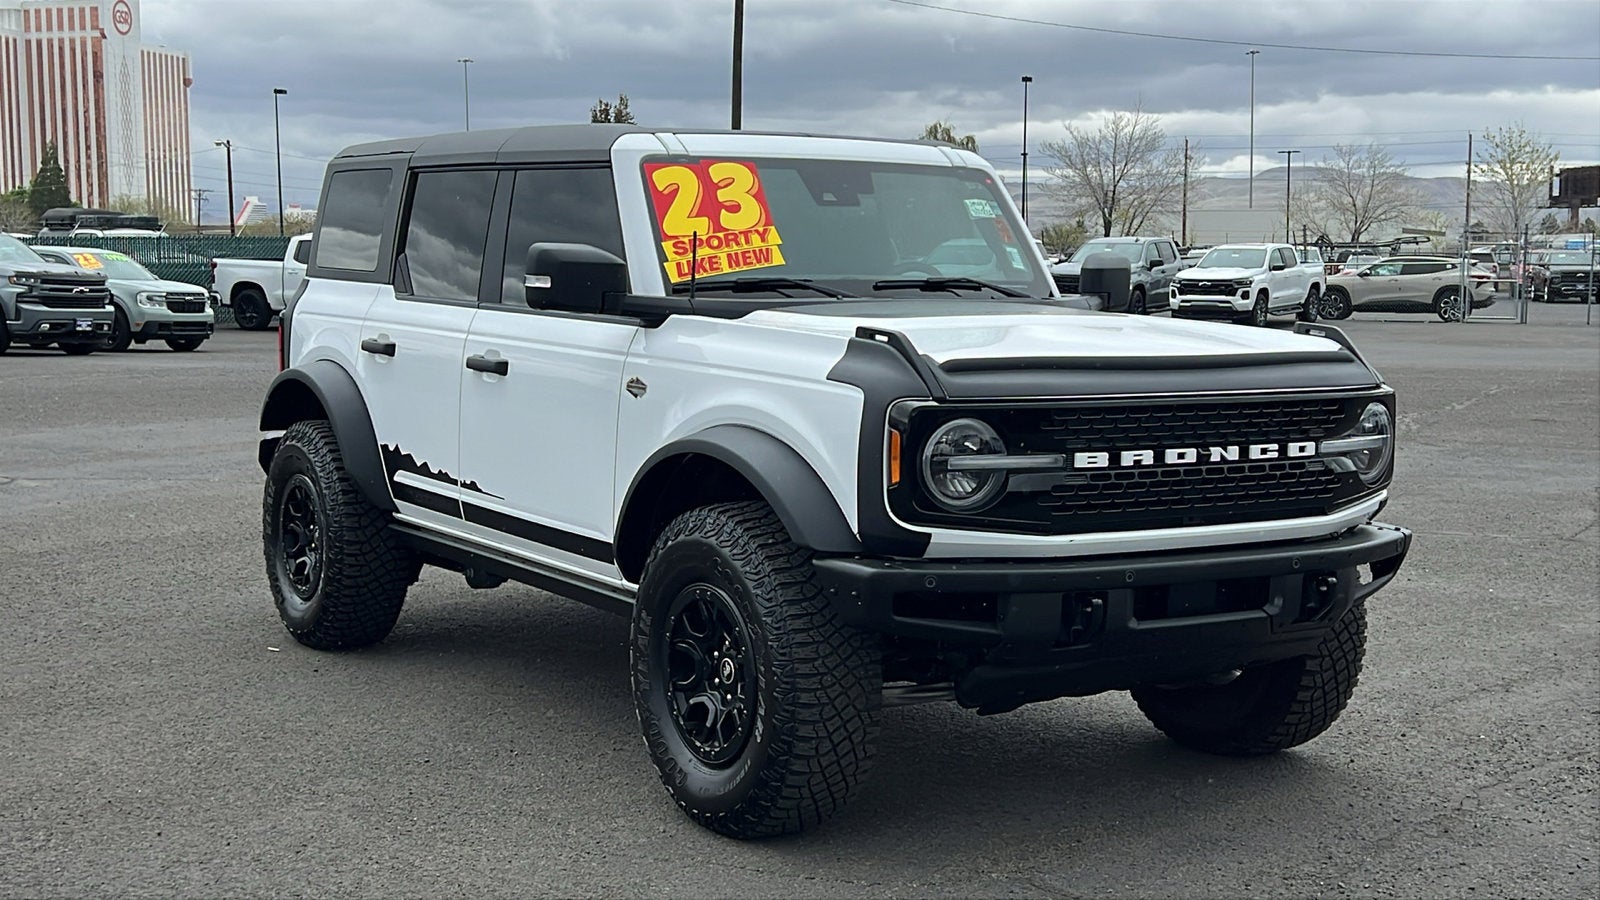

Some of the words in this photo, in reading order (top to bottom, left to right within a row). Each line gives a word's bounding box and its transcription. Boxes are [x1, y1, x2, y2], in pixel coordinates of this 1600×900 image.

[114, 9, 130, 25] GSR
[652, 162, 767, 236] 23
[672, 228, 769, 257] SPORTY
[676, 254, 723, 279] LIKE
[726, 247, 773, 269] NEW
[1074, 441, 1316, 469] BRONCO
